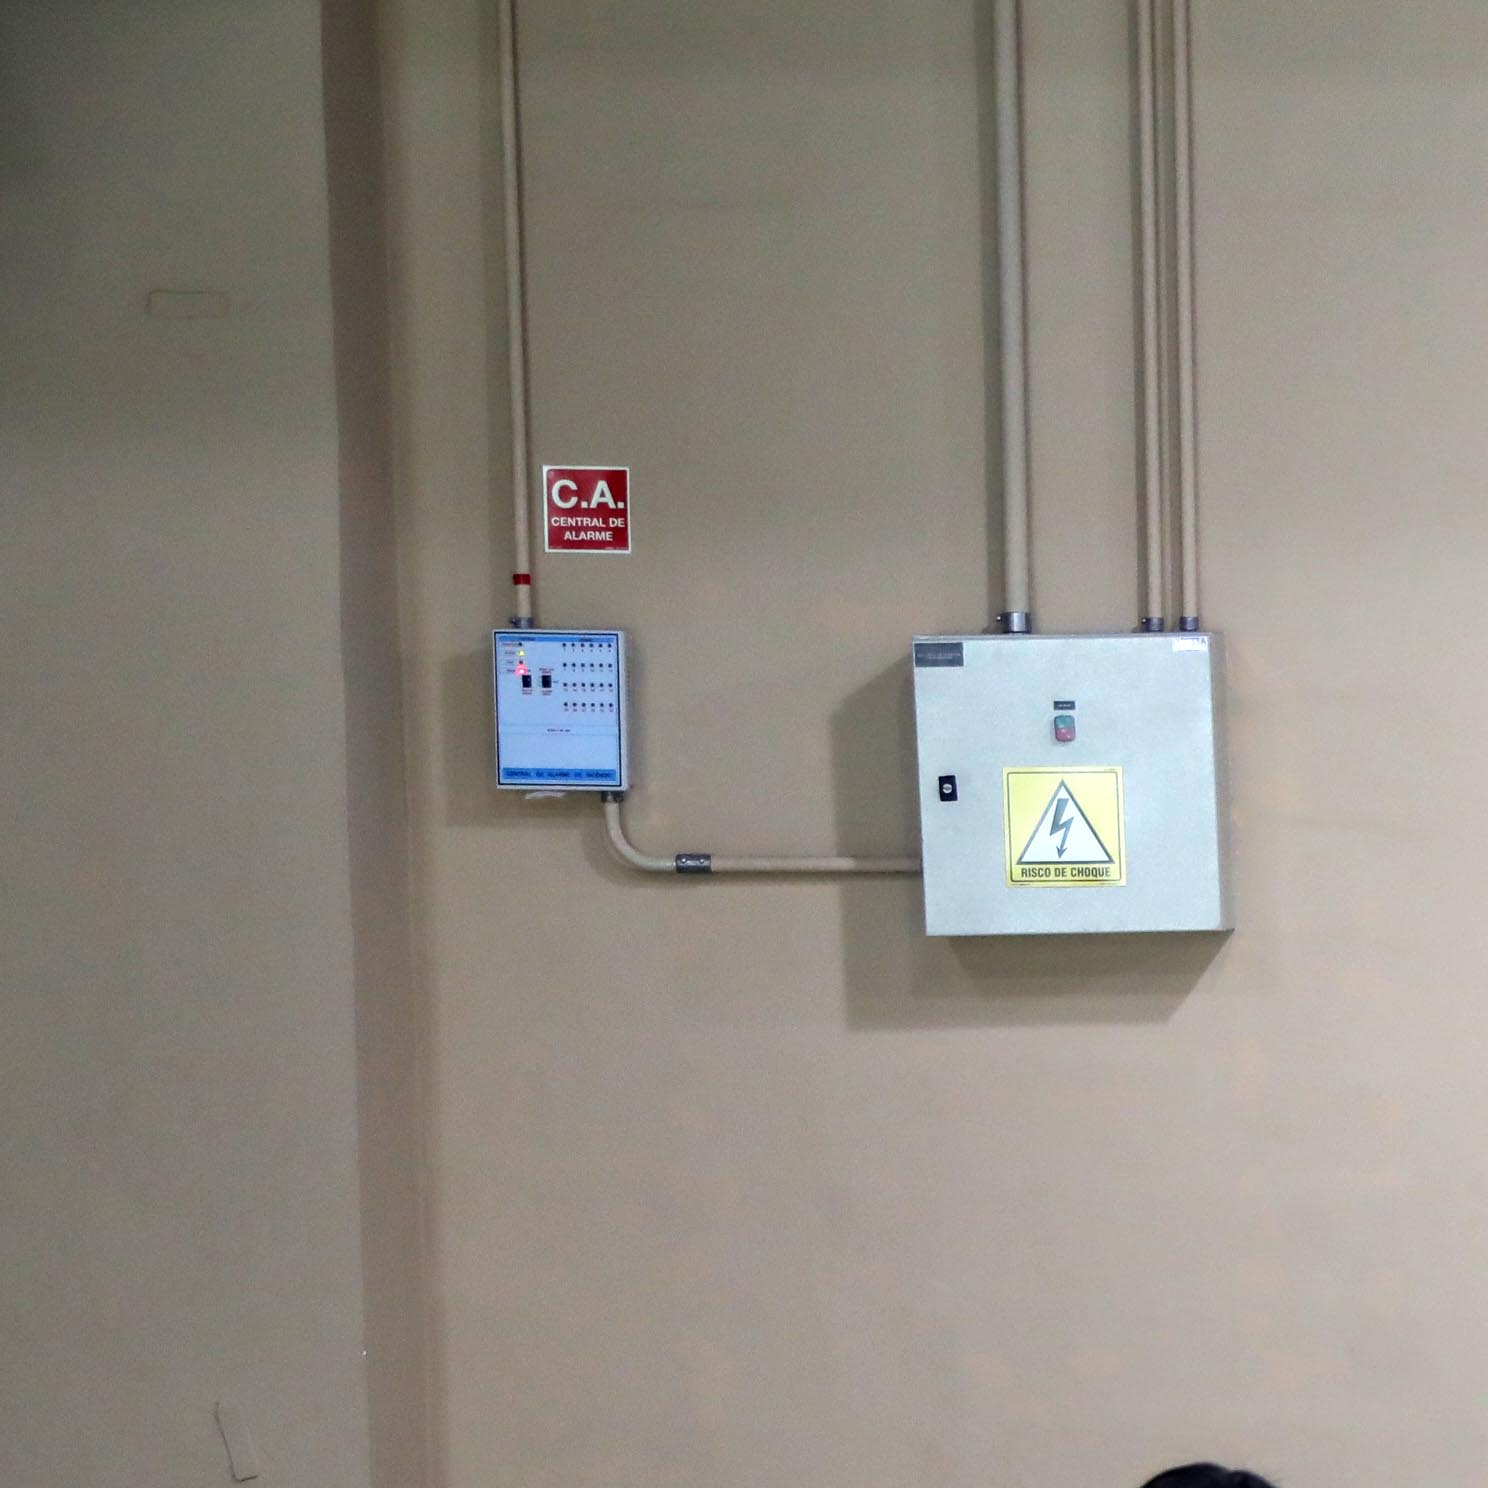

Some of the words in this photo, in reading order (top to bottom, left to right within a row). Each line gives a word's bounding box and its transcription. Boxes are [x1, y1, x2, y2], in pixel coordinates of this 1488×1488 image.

[552, 479, 625, 509] C.A.
[551, 516, 606, 529] CENTRAL
[608, 517, 626, 529] DE
[563, 530, 614, 541] ALARME
[1021, 867, 1051, 878] RISCO
[1054, 867, 1068, 878] DE
[1070, 866, 1111, 878] CHOQUE
